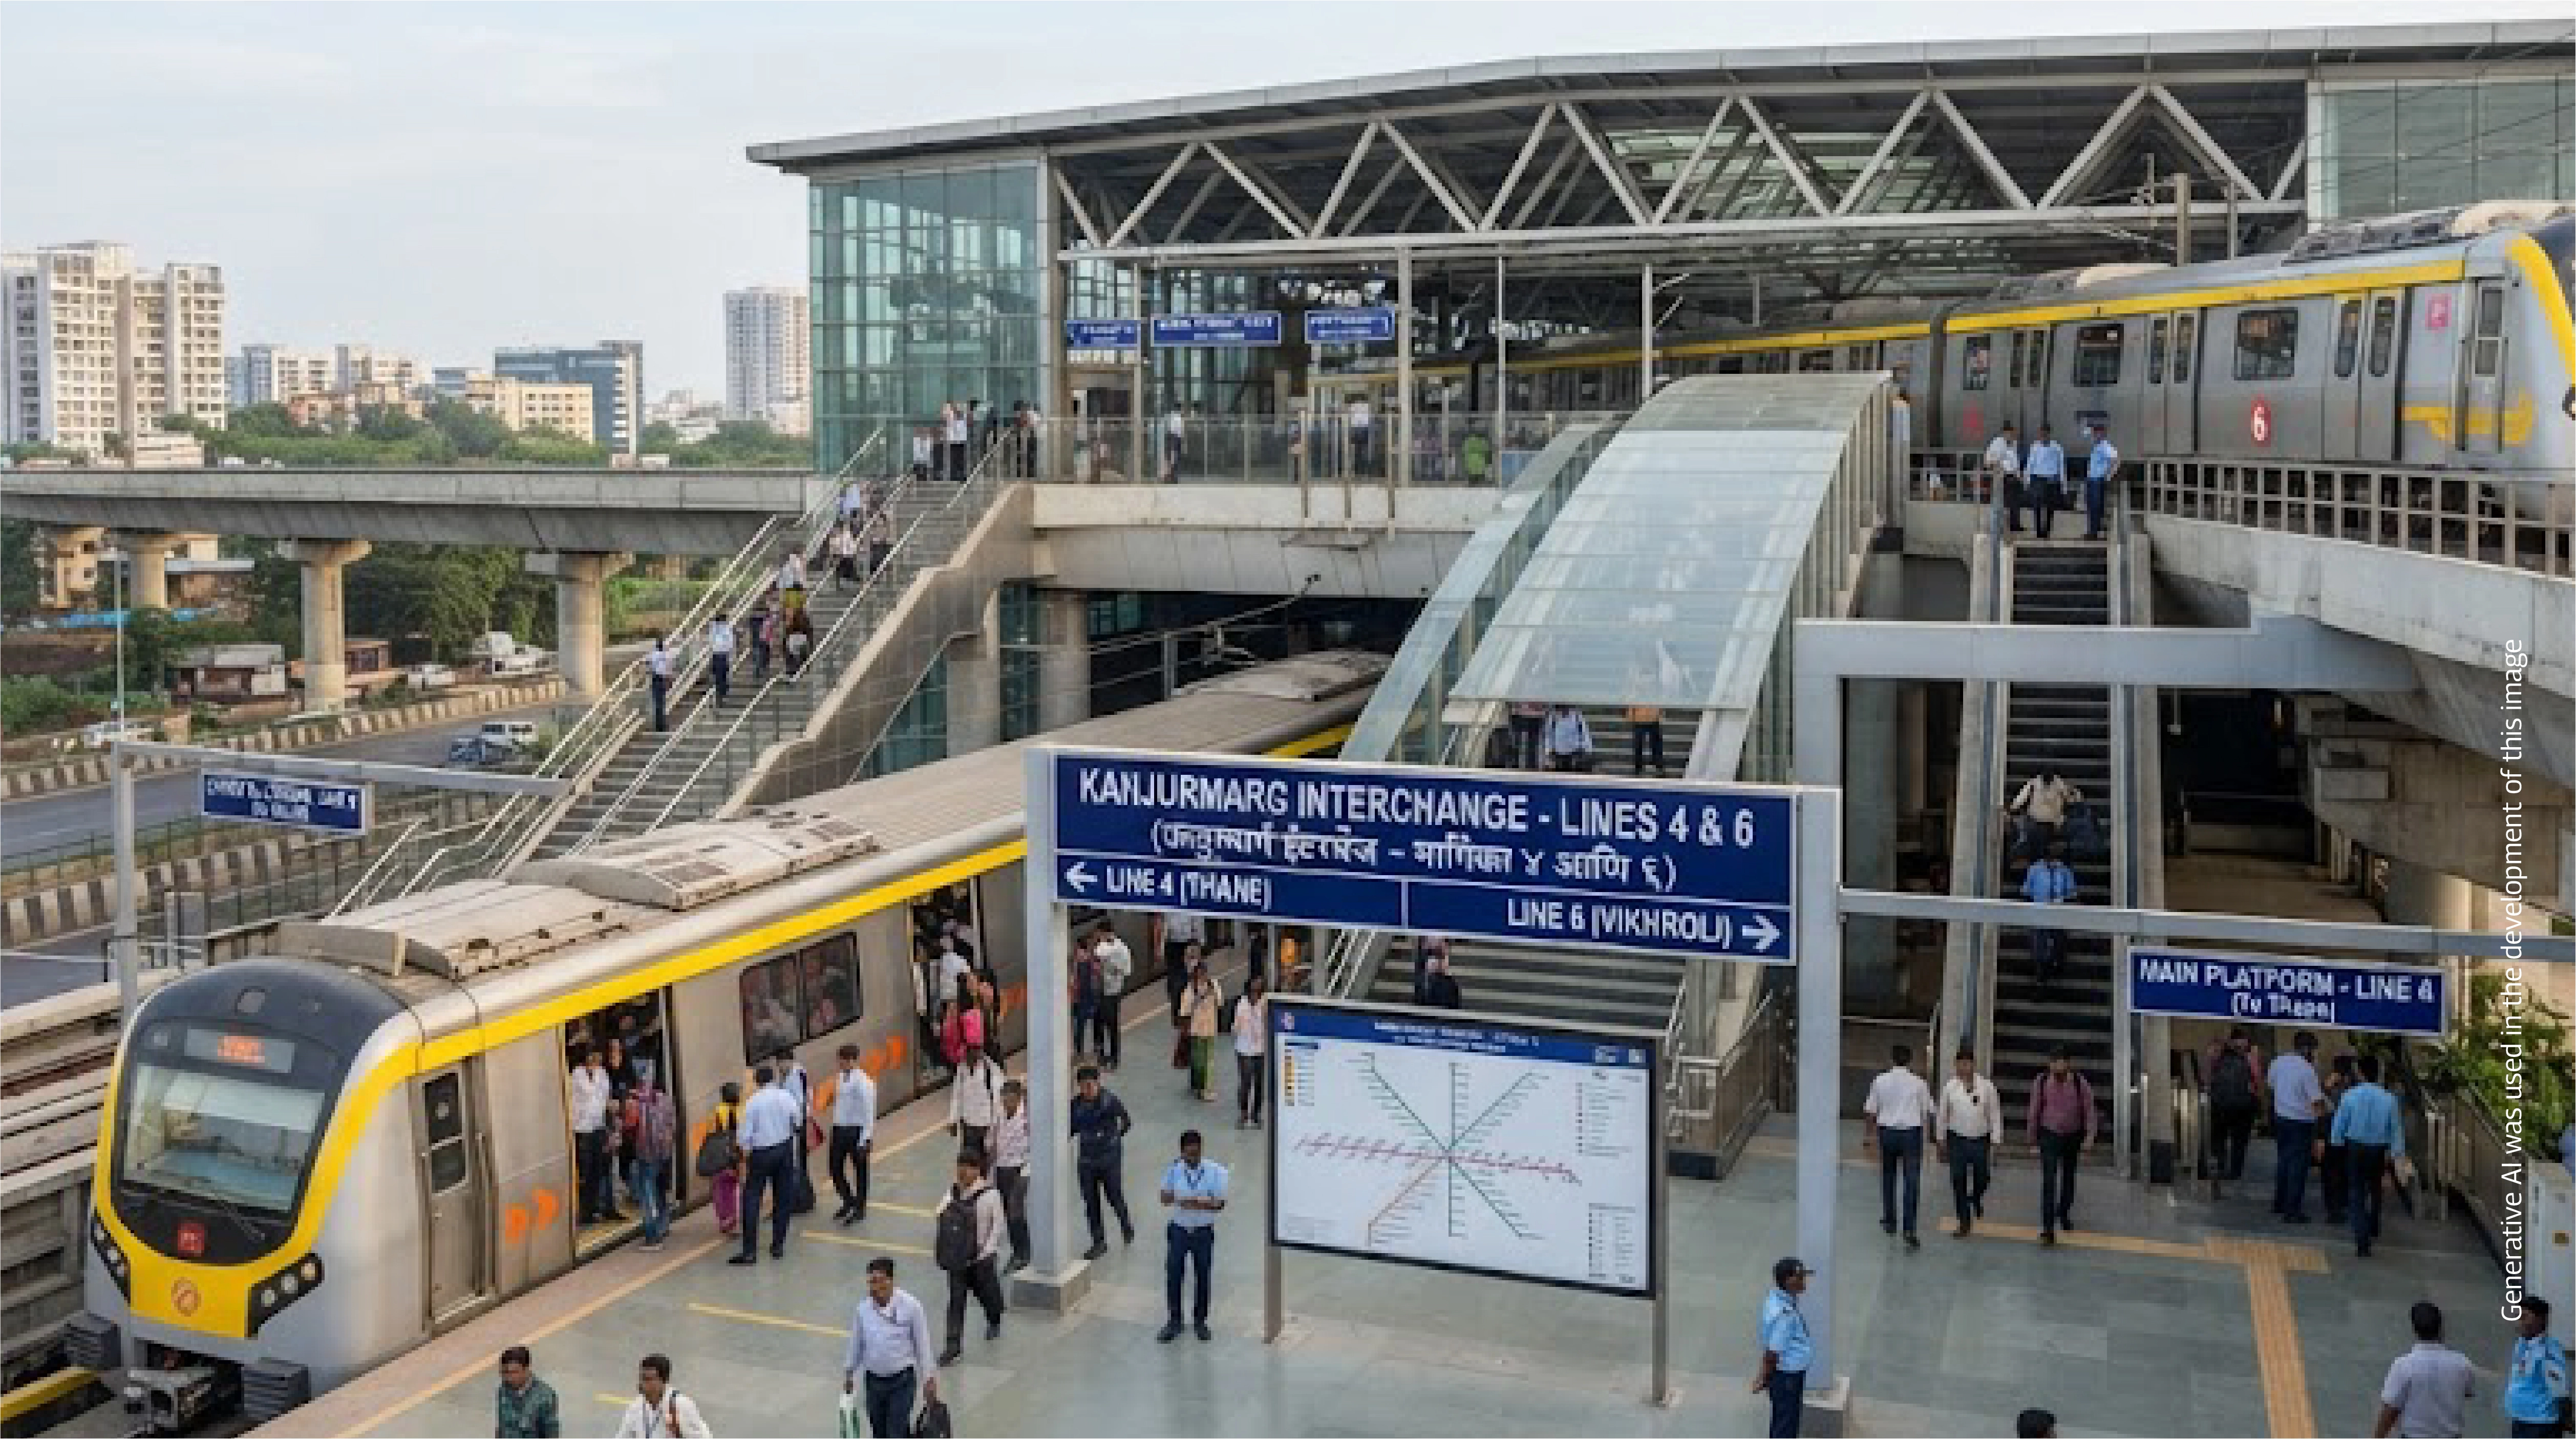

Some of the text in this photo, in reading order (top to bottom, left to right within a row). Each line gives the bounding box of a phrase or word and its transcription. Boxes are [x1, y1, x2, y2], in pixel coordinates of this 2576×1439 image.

[1080, 768, 1288, 816] KANJURMARG
[1297, 781, 1529, 832] INTERCHANGE
[1561, 797, 1657, 842] LINES
[1669, 805, 1689, 842] 4
[1698, 805, 1723, 846] &
[1735, 808, 1753, 848] 6
[1106, 865, 1272, 912] LINE 4 (THANE)
[1508, 899, 1563, 929] LINE
[2140, 959, 2199, 983] MAIN
[2355, 975, 2412, 1002] LINE
